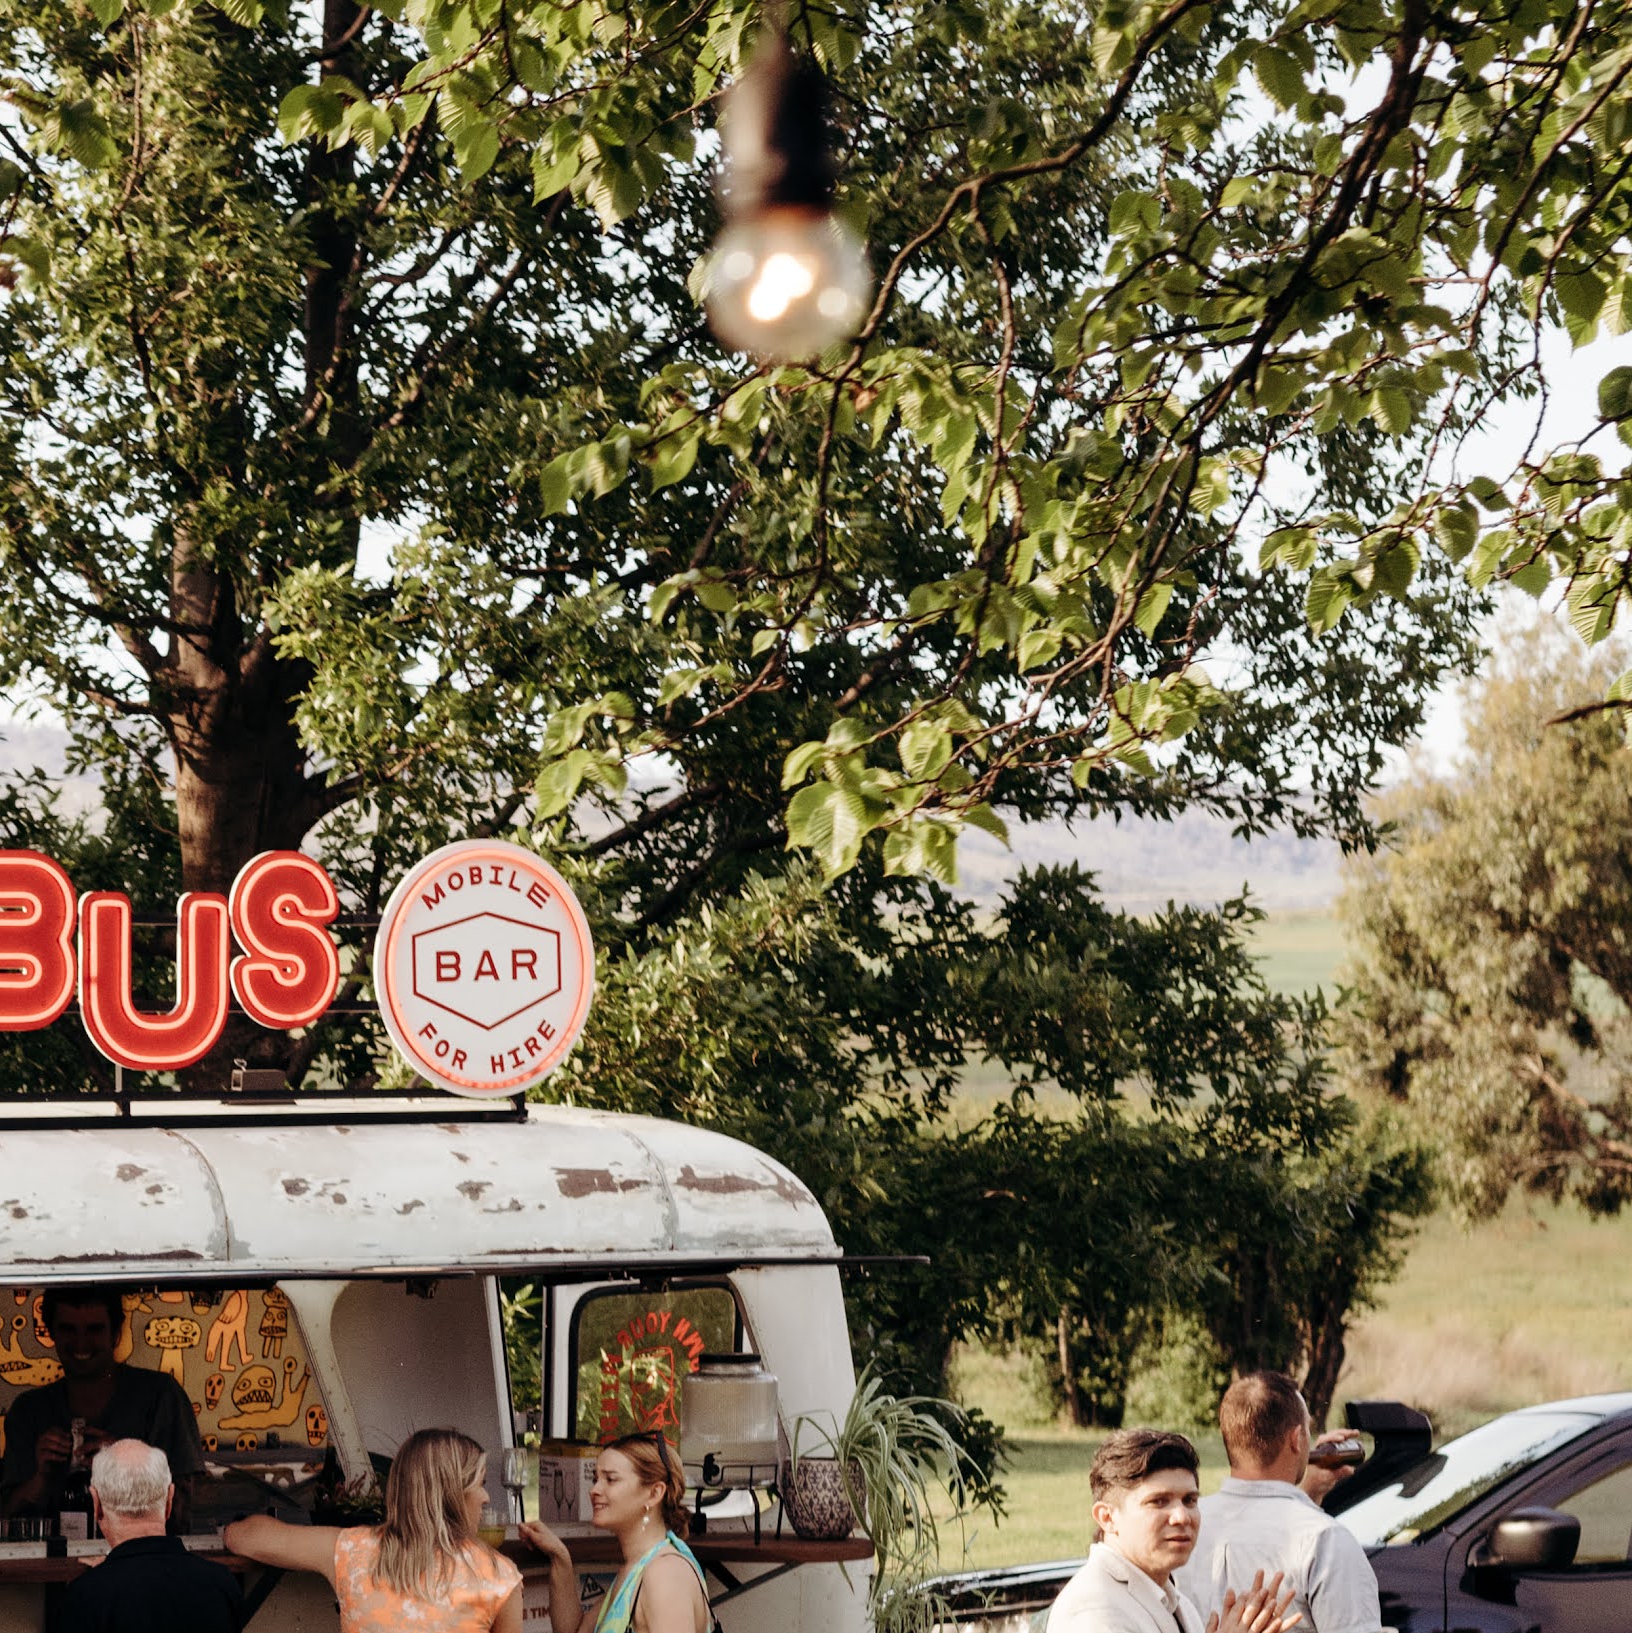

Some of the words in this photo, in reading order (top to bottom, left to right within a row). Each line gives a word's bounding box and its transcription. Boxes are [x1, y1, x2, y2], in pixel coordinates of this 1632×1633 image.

[421, 865, 551, 911] MOBILE
[435, 949, 538, 982] BAR
[419, 1022, 468, 1070] FOR
[490, 1019, 556, 1074] HIRE
